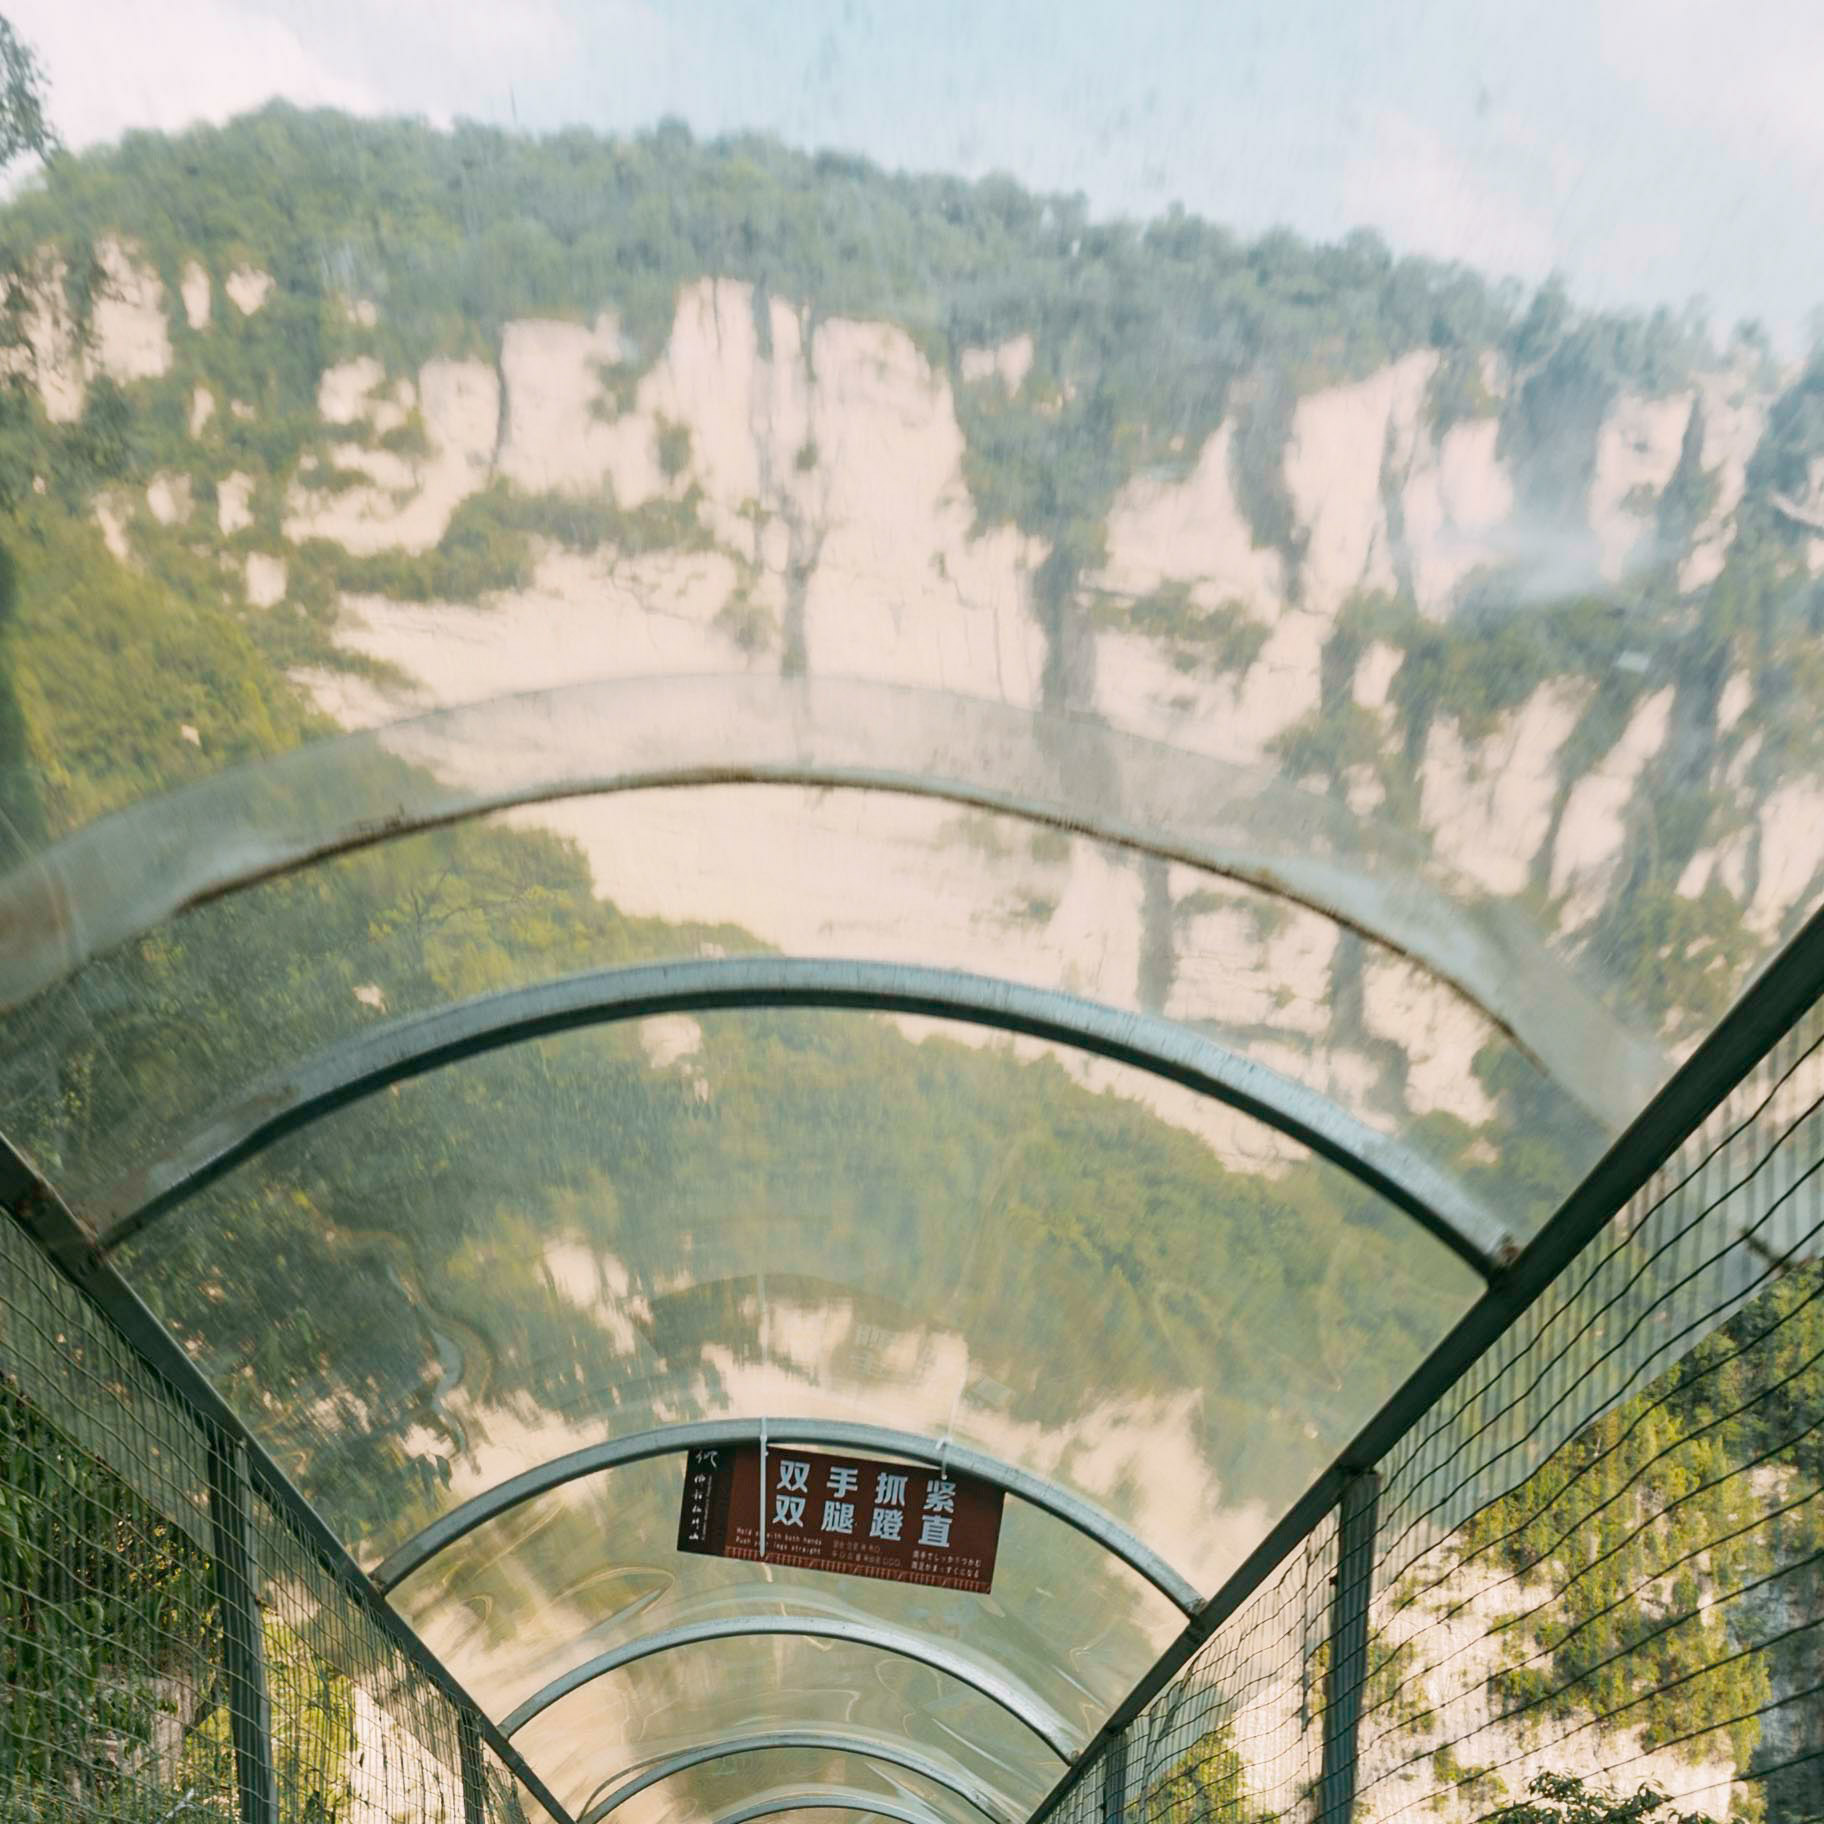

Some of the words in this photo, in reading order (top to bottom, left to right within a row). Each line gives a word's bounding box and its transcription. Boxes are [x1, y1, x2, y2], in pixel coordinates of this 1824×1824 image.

[776, 1460, 956, 1513] 双手抓紧
[772, 1494, 953, 1548] 双腿蹬直
